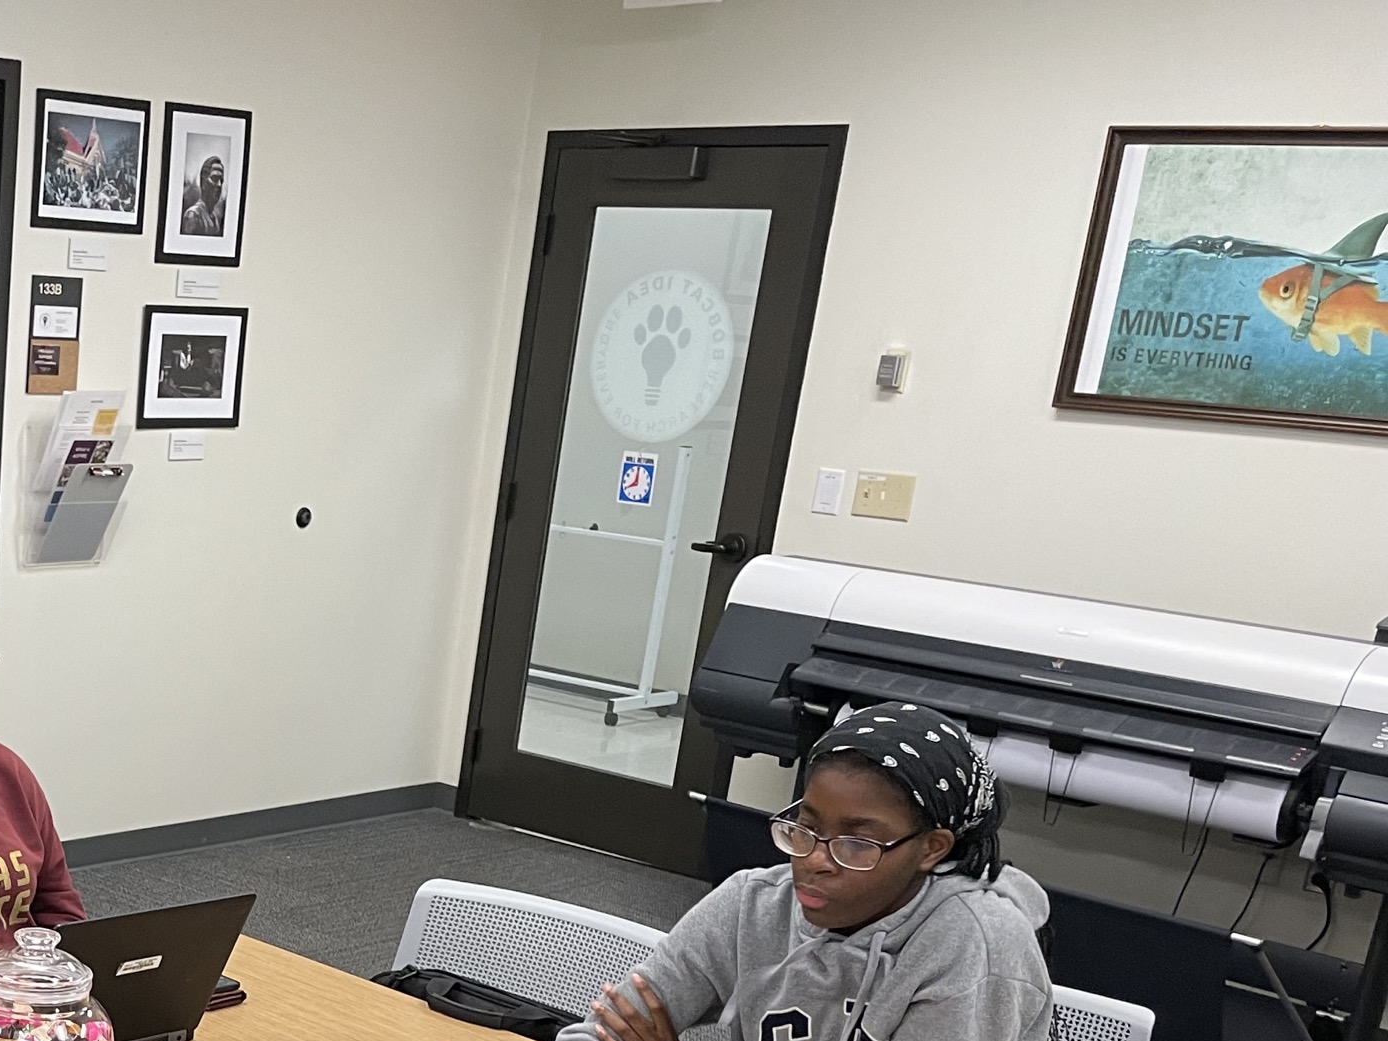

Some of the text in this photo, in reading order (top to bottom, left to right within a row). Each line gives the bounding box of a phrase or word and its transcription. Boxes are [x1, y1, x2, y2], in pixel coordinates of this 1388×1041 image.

[39, 283, 63, 295] 133B
[1117, 308, 1252, 342] MINDSET
[1111, 346, 1254, 371] IS EVERYTHING
